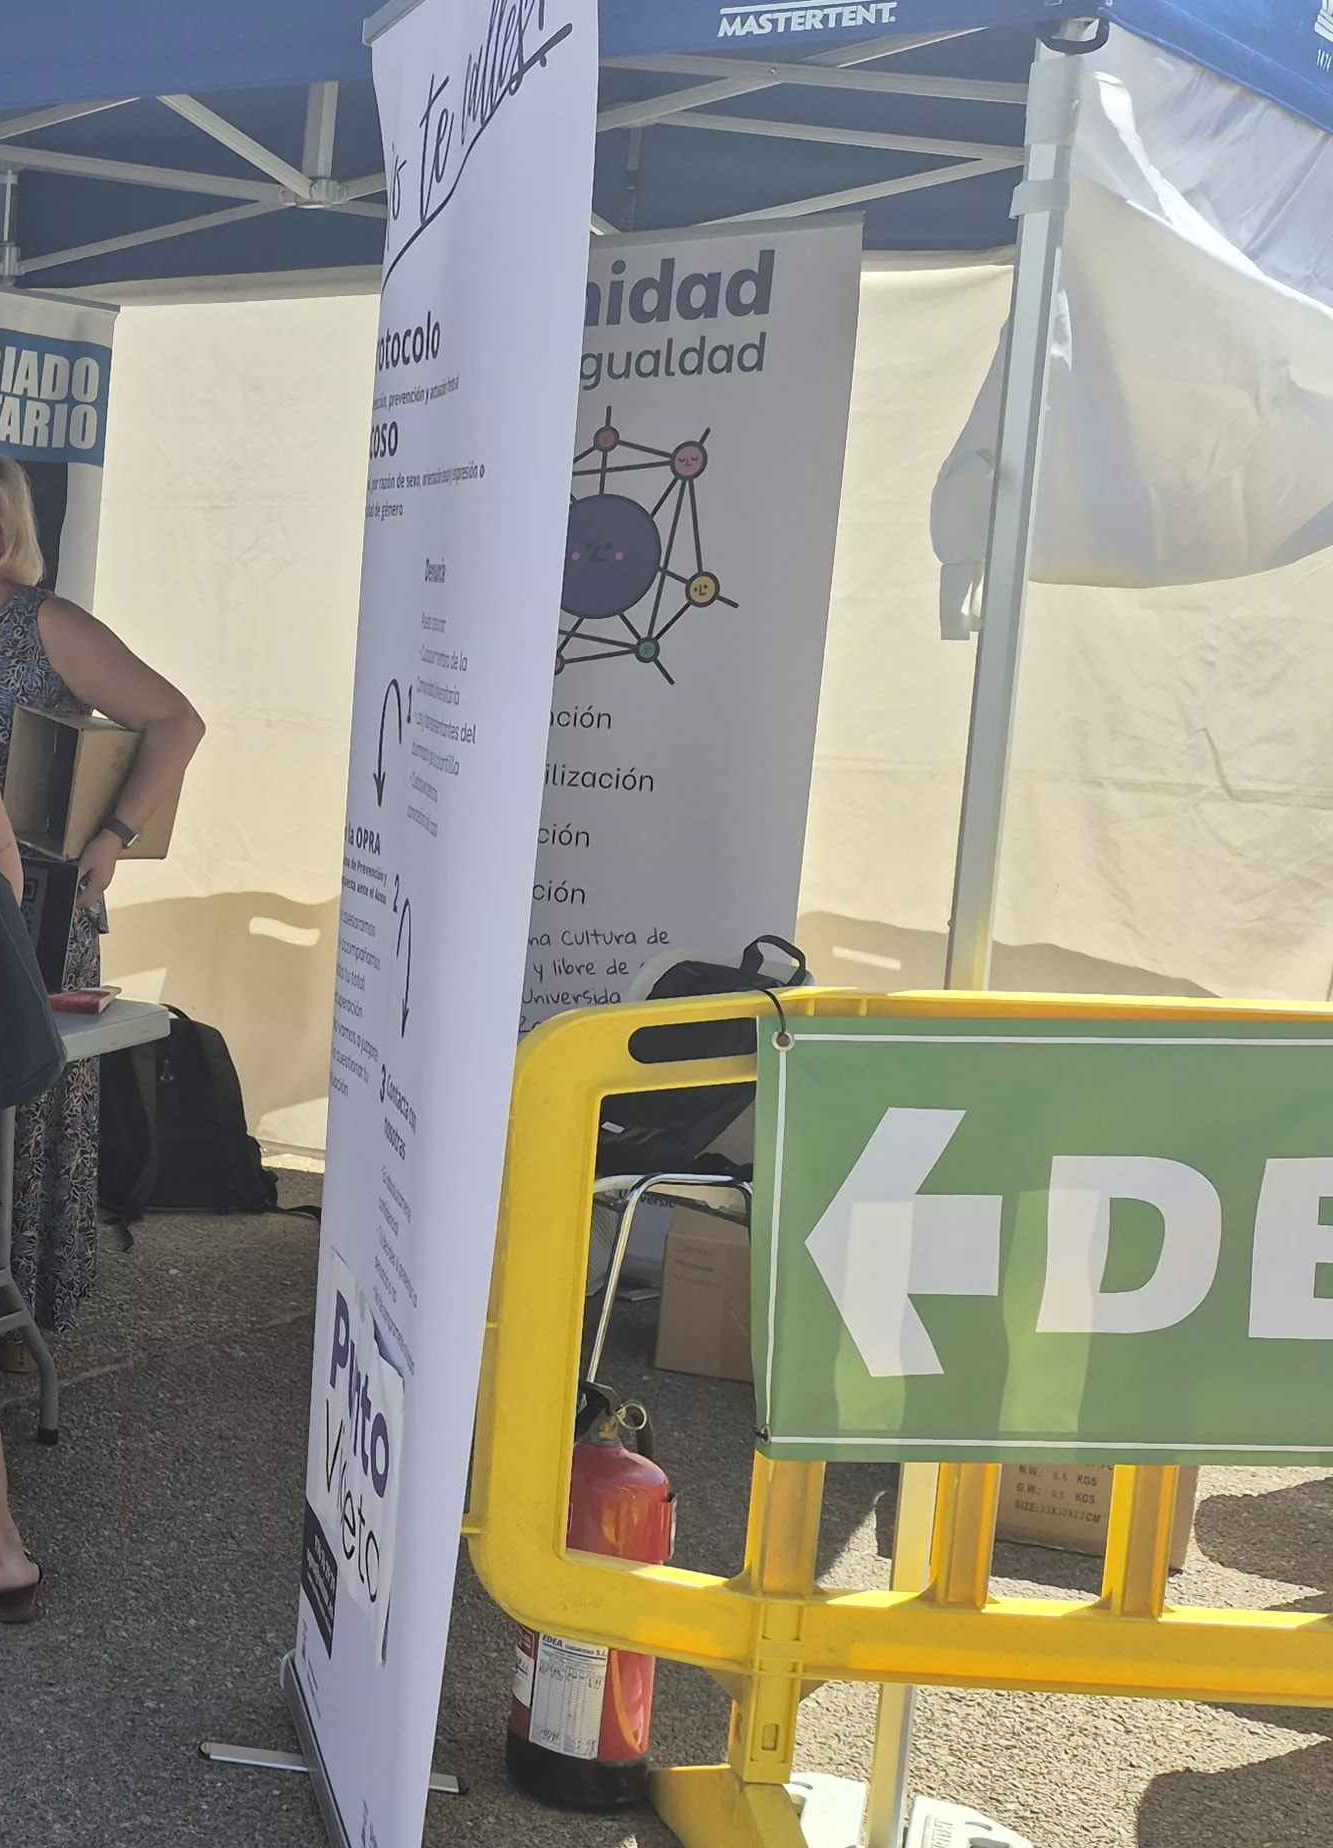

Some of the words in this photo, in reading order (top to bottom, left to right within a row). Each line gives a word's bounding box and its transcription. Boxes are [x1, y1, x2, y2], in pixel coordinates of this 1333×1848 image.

[579, 331, 768, 391] gualdad
[396, 471, 405, 488] de
[460, 721, 477, 745] del
[355, 826, 381, 856] OPRA
[392, 873, 400, 914] 2
[532, 879, 586, 905] ción
[646, 927, 671, 945] de
[533, 962, 544, 983] y
[552, 956, 597, 976] libre
[605, 957, 630, 976] de
[379, 1063, 387, 1104] 3
[1076, 1474, 1099, 1488] KGS
[1074, 1491, 1097, 1506] KGS
